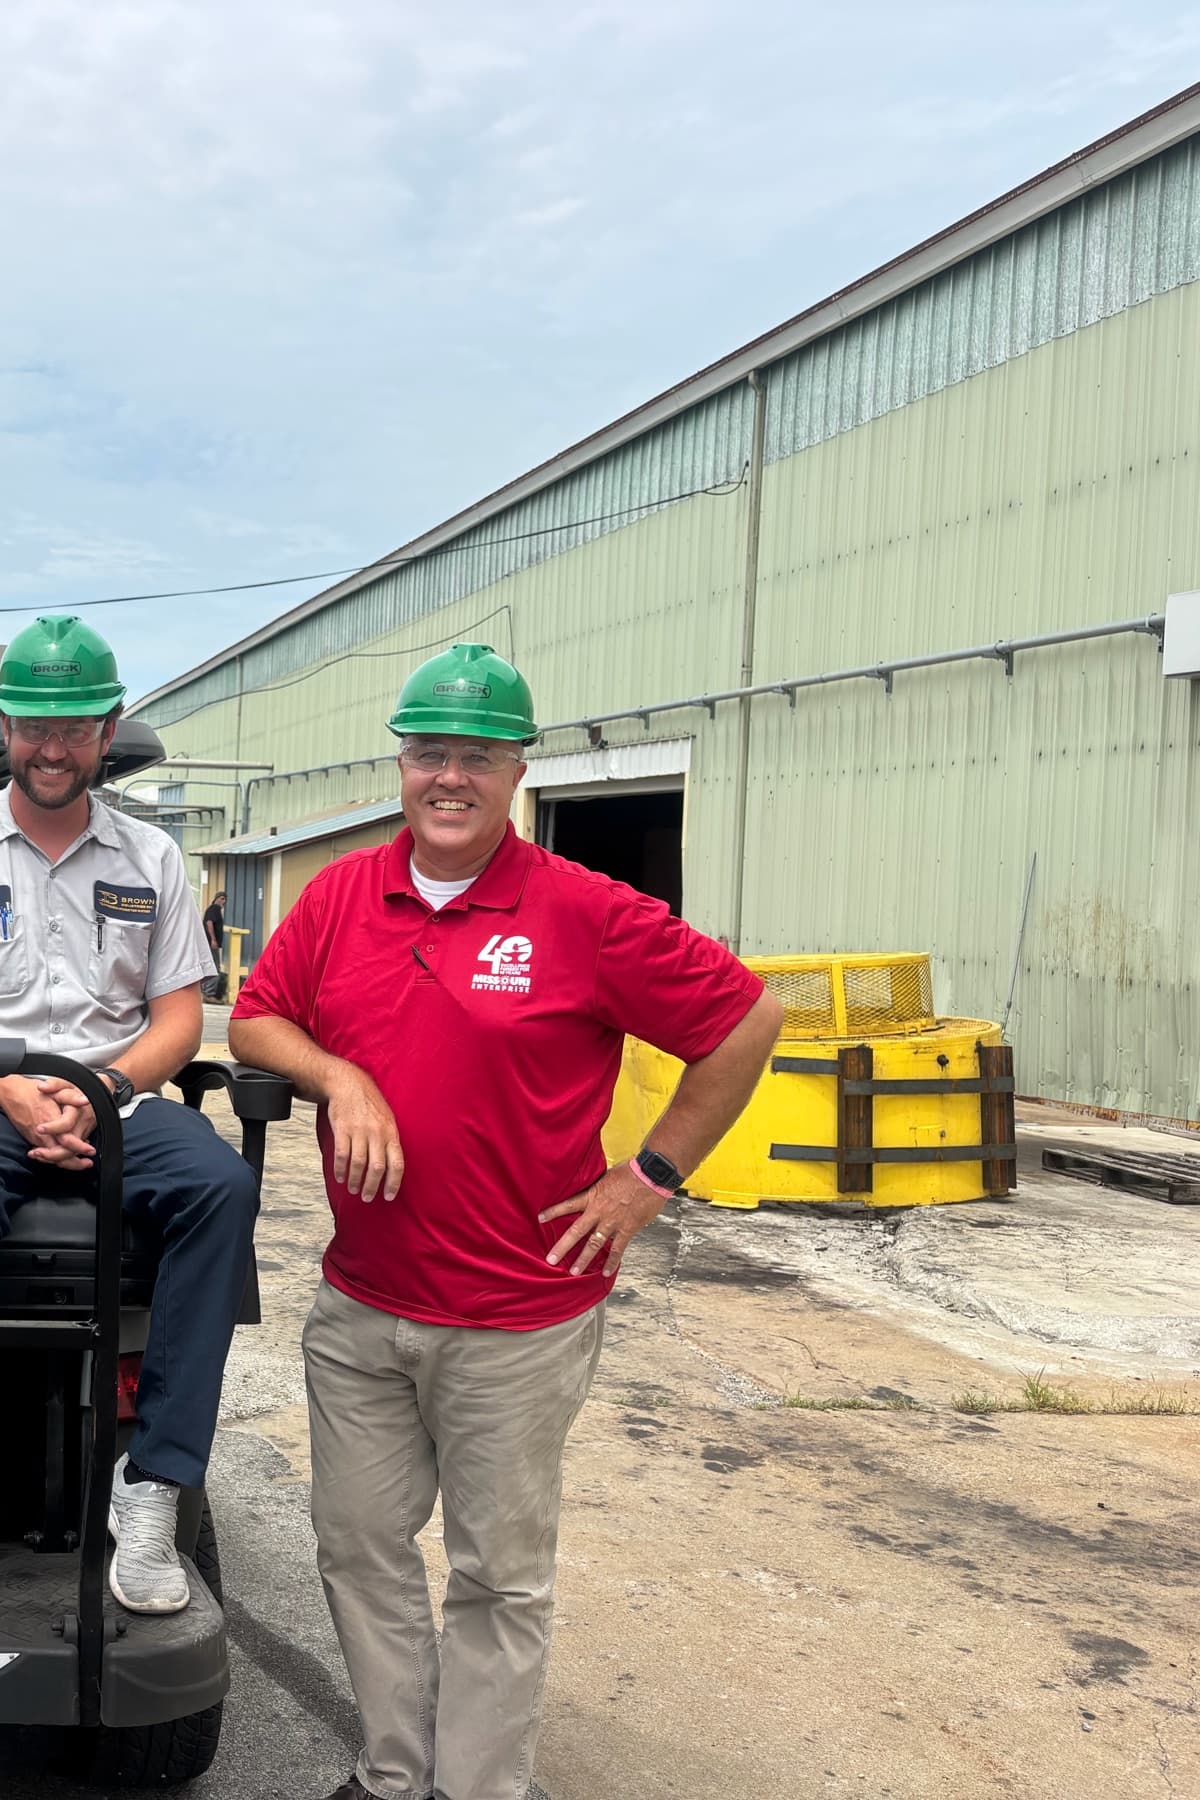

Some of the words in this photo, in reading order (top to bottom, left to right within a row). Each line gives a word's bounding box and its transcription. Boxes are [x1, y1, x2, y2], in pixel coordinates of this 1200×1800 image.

[33, 664, 80, 673] BROCK
[120, 896, 155, 905] BROWN
[472, 974, 531, 987] MISSOURI
[471, 983, 530, 993] ENTERPRISE
